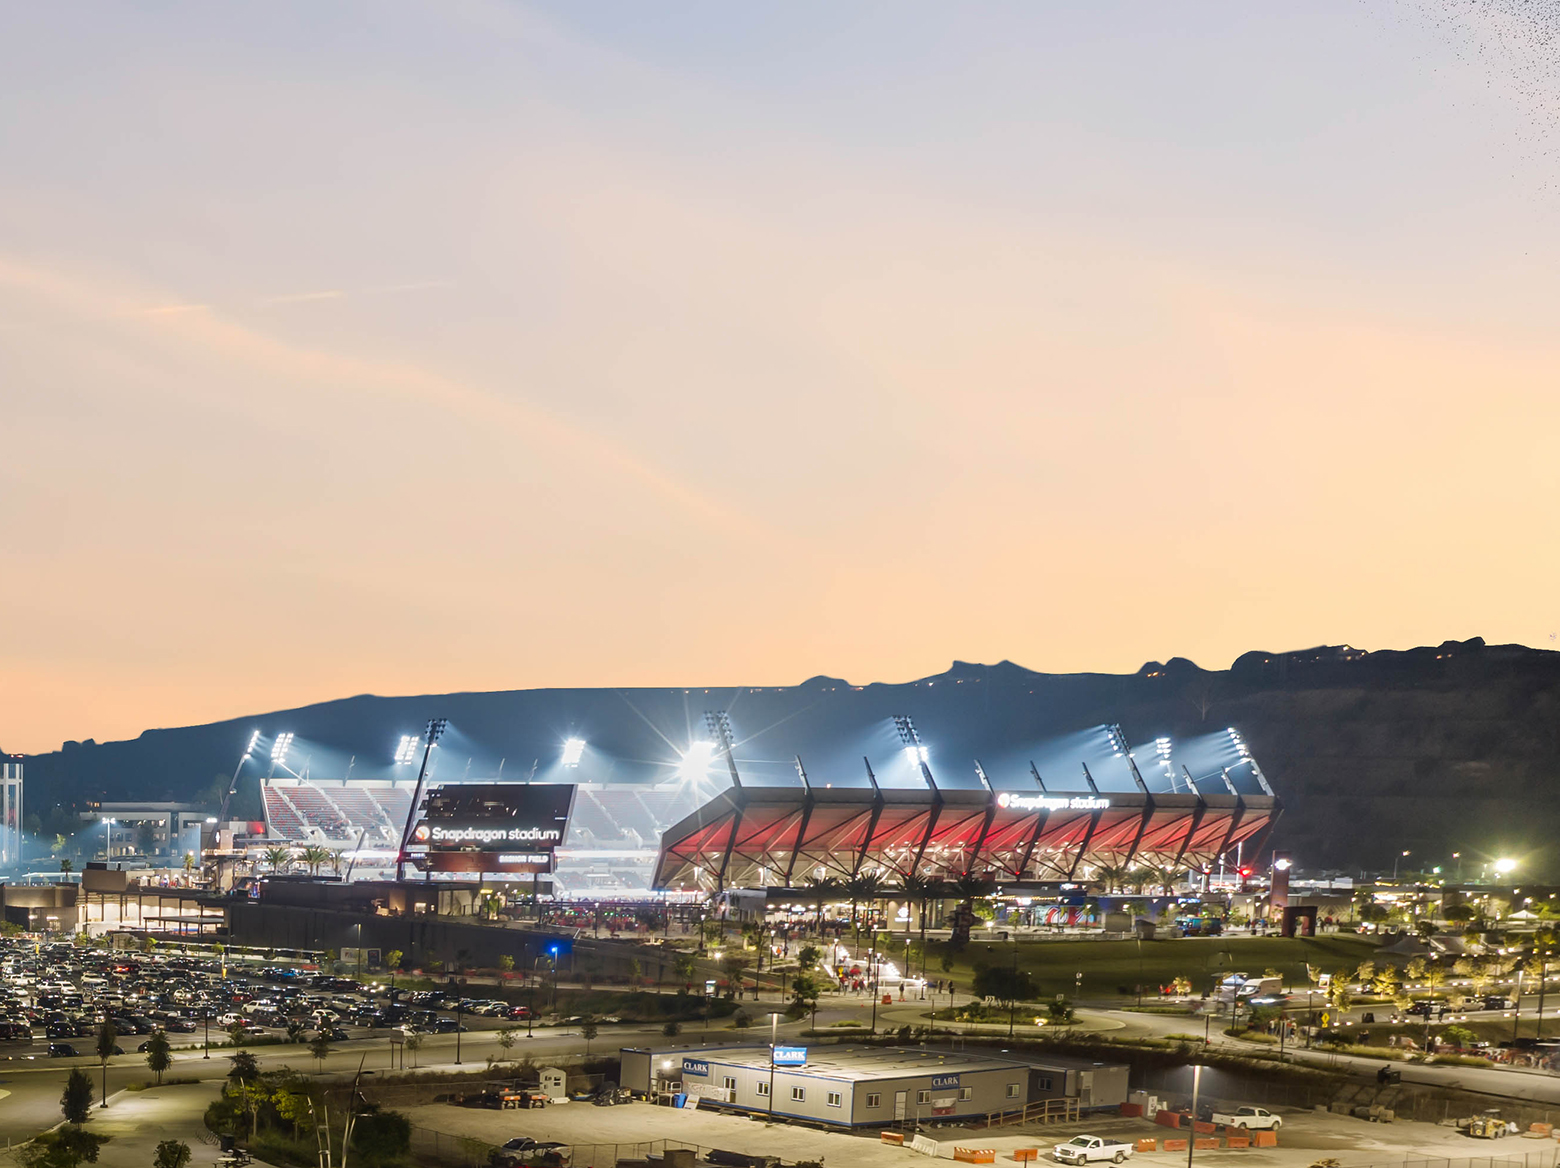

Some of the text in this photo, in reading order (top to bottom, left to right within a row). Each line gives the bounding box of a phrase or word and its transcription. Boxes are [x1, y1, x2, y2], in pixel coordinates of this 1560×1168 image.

[1009, 794, 1110, 811] Snapdragon stadium
[432, 826, 560, 842] Snapdragon stadium
[773, 1050, 806, 1060] CLARK
[683, 1061, 708, 1073] CLARK
[932, 1076, 959, 1087] CLARK
